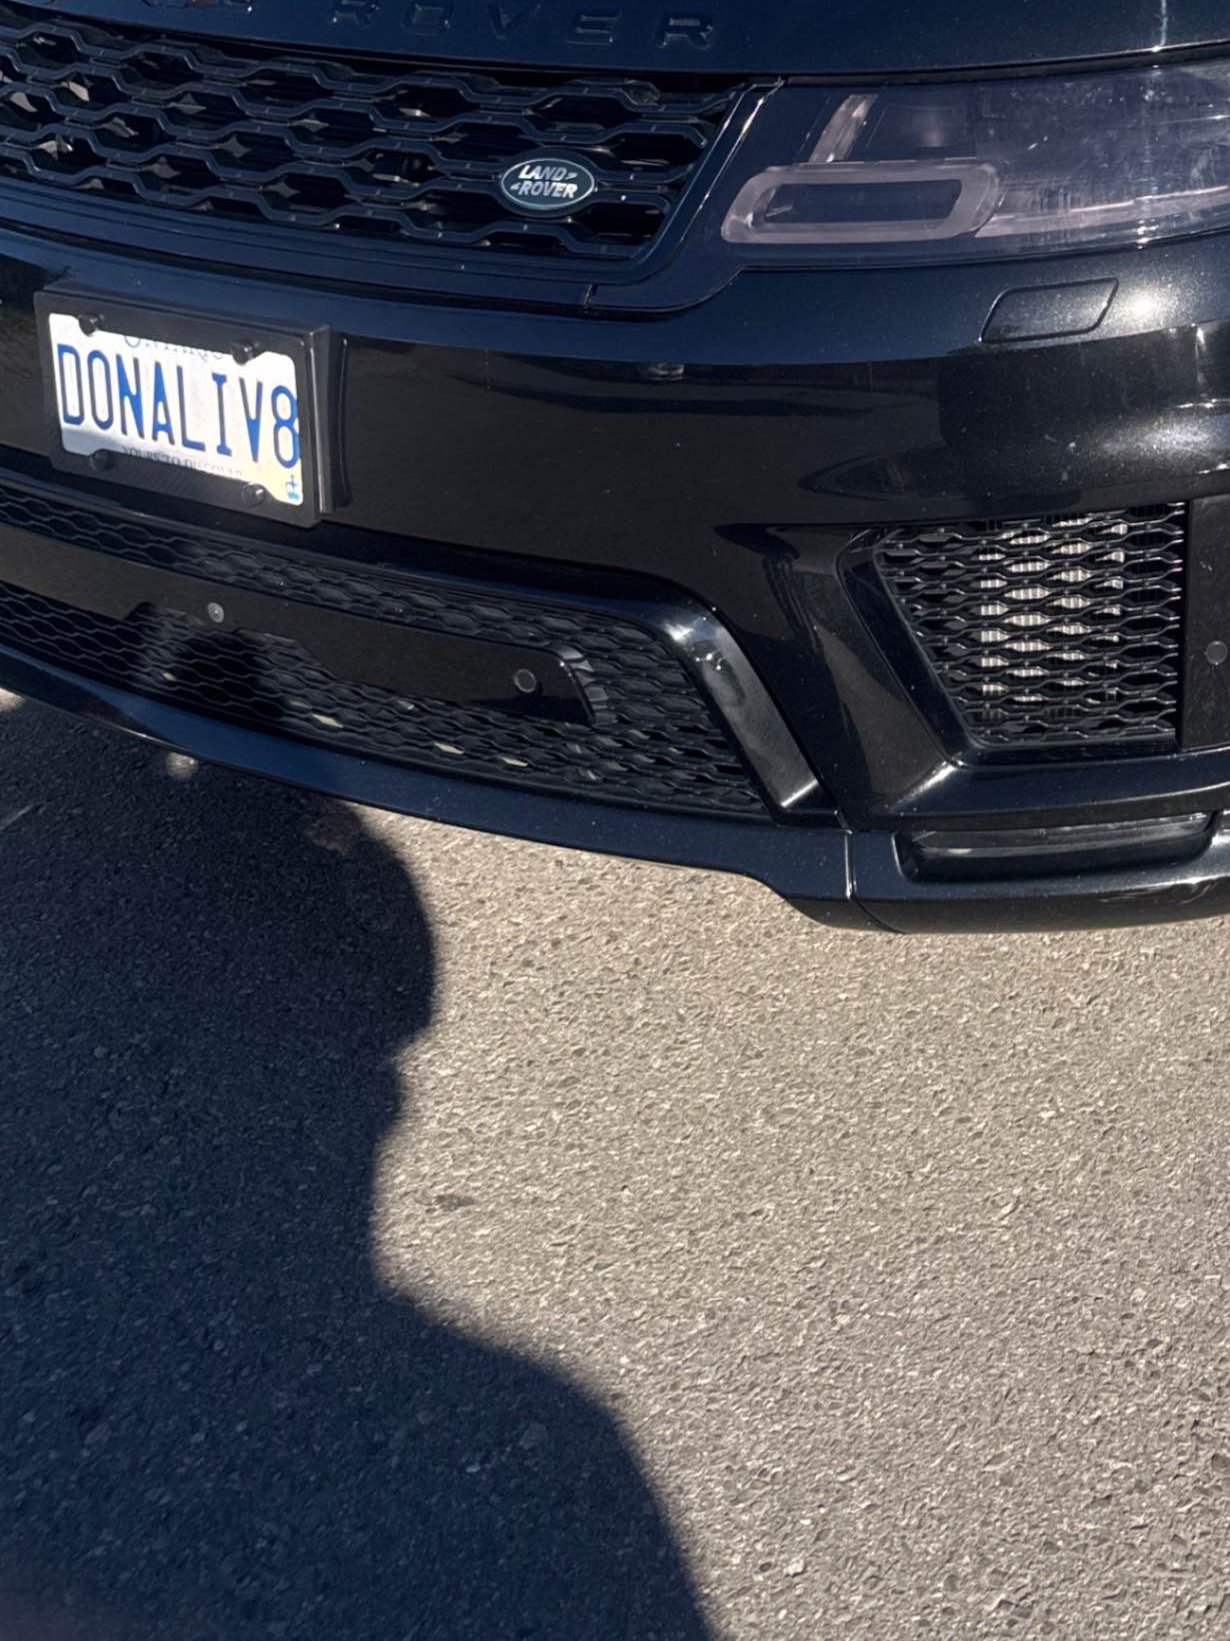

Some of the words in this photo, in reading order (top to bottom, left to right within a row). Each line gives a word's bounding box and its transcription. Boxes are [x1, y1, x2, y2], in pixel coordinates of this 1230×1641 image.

[518, 164, 567, 181] LAND
[517, 180, 579, 199] ROVER
[57, 343, 301, 469] DONALIV8
